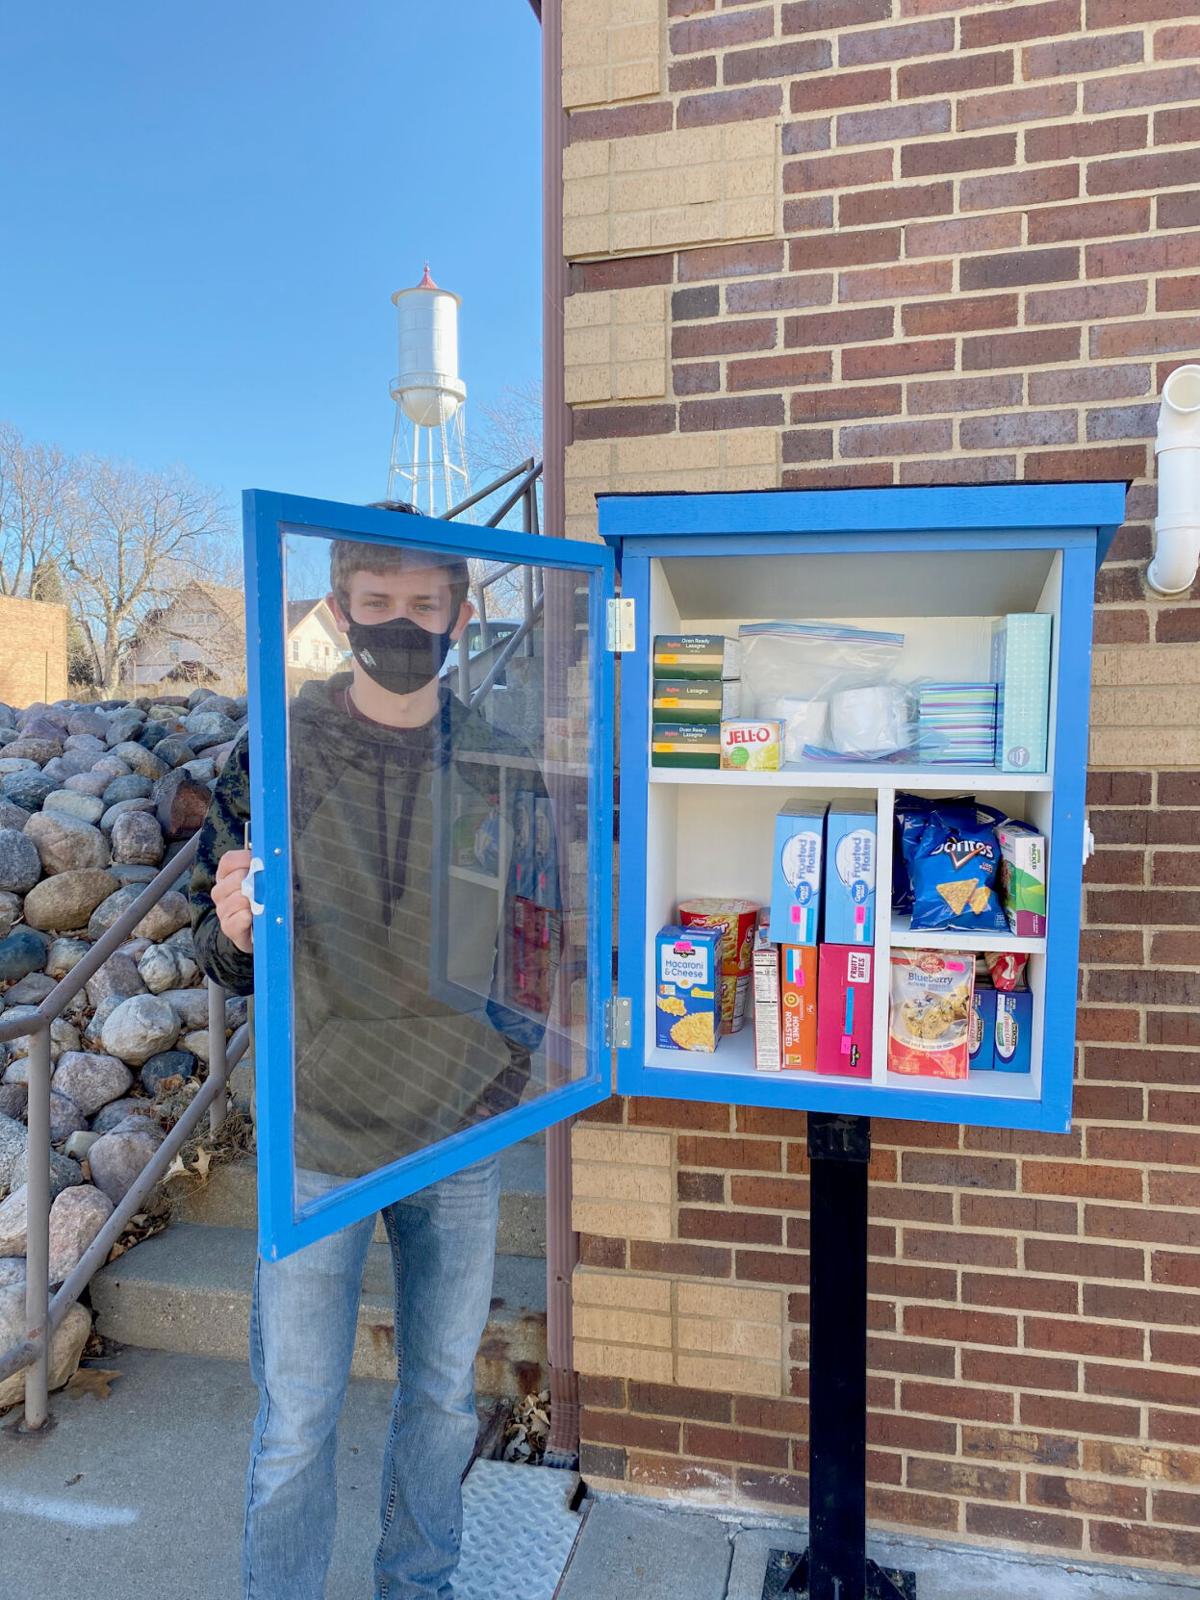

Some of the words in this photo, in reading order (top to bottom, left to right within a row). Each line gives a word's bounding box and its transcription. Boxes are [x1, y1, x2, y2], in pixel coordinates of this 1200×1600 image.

[797, 839, 807, 879] Frosted
[807, 840, 816, 873] Flakes
[852, 837, 861, 878] Frosted
[862, 838, 871, 872] Flakes
[664, 968, 671, 976] &
[671, 968, 704, 978] Cheese
[665, 959, 704, 970] Macaroni
[850, 954, 858, 979] FRUITY
[857, 957, 865, 979] BITES
[908, 971, 953, 985] Blueberry
[785, 1011, 793, 1047] ROASTED
[792, 1016, 800, 1044] HONEY
